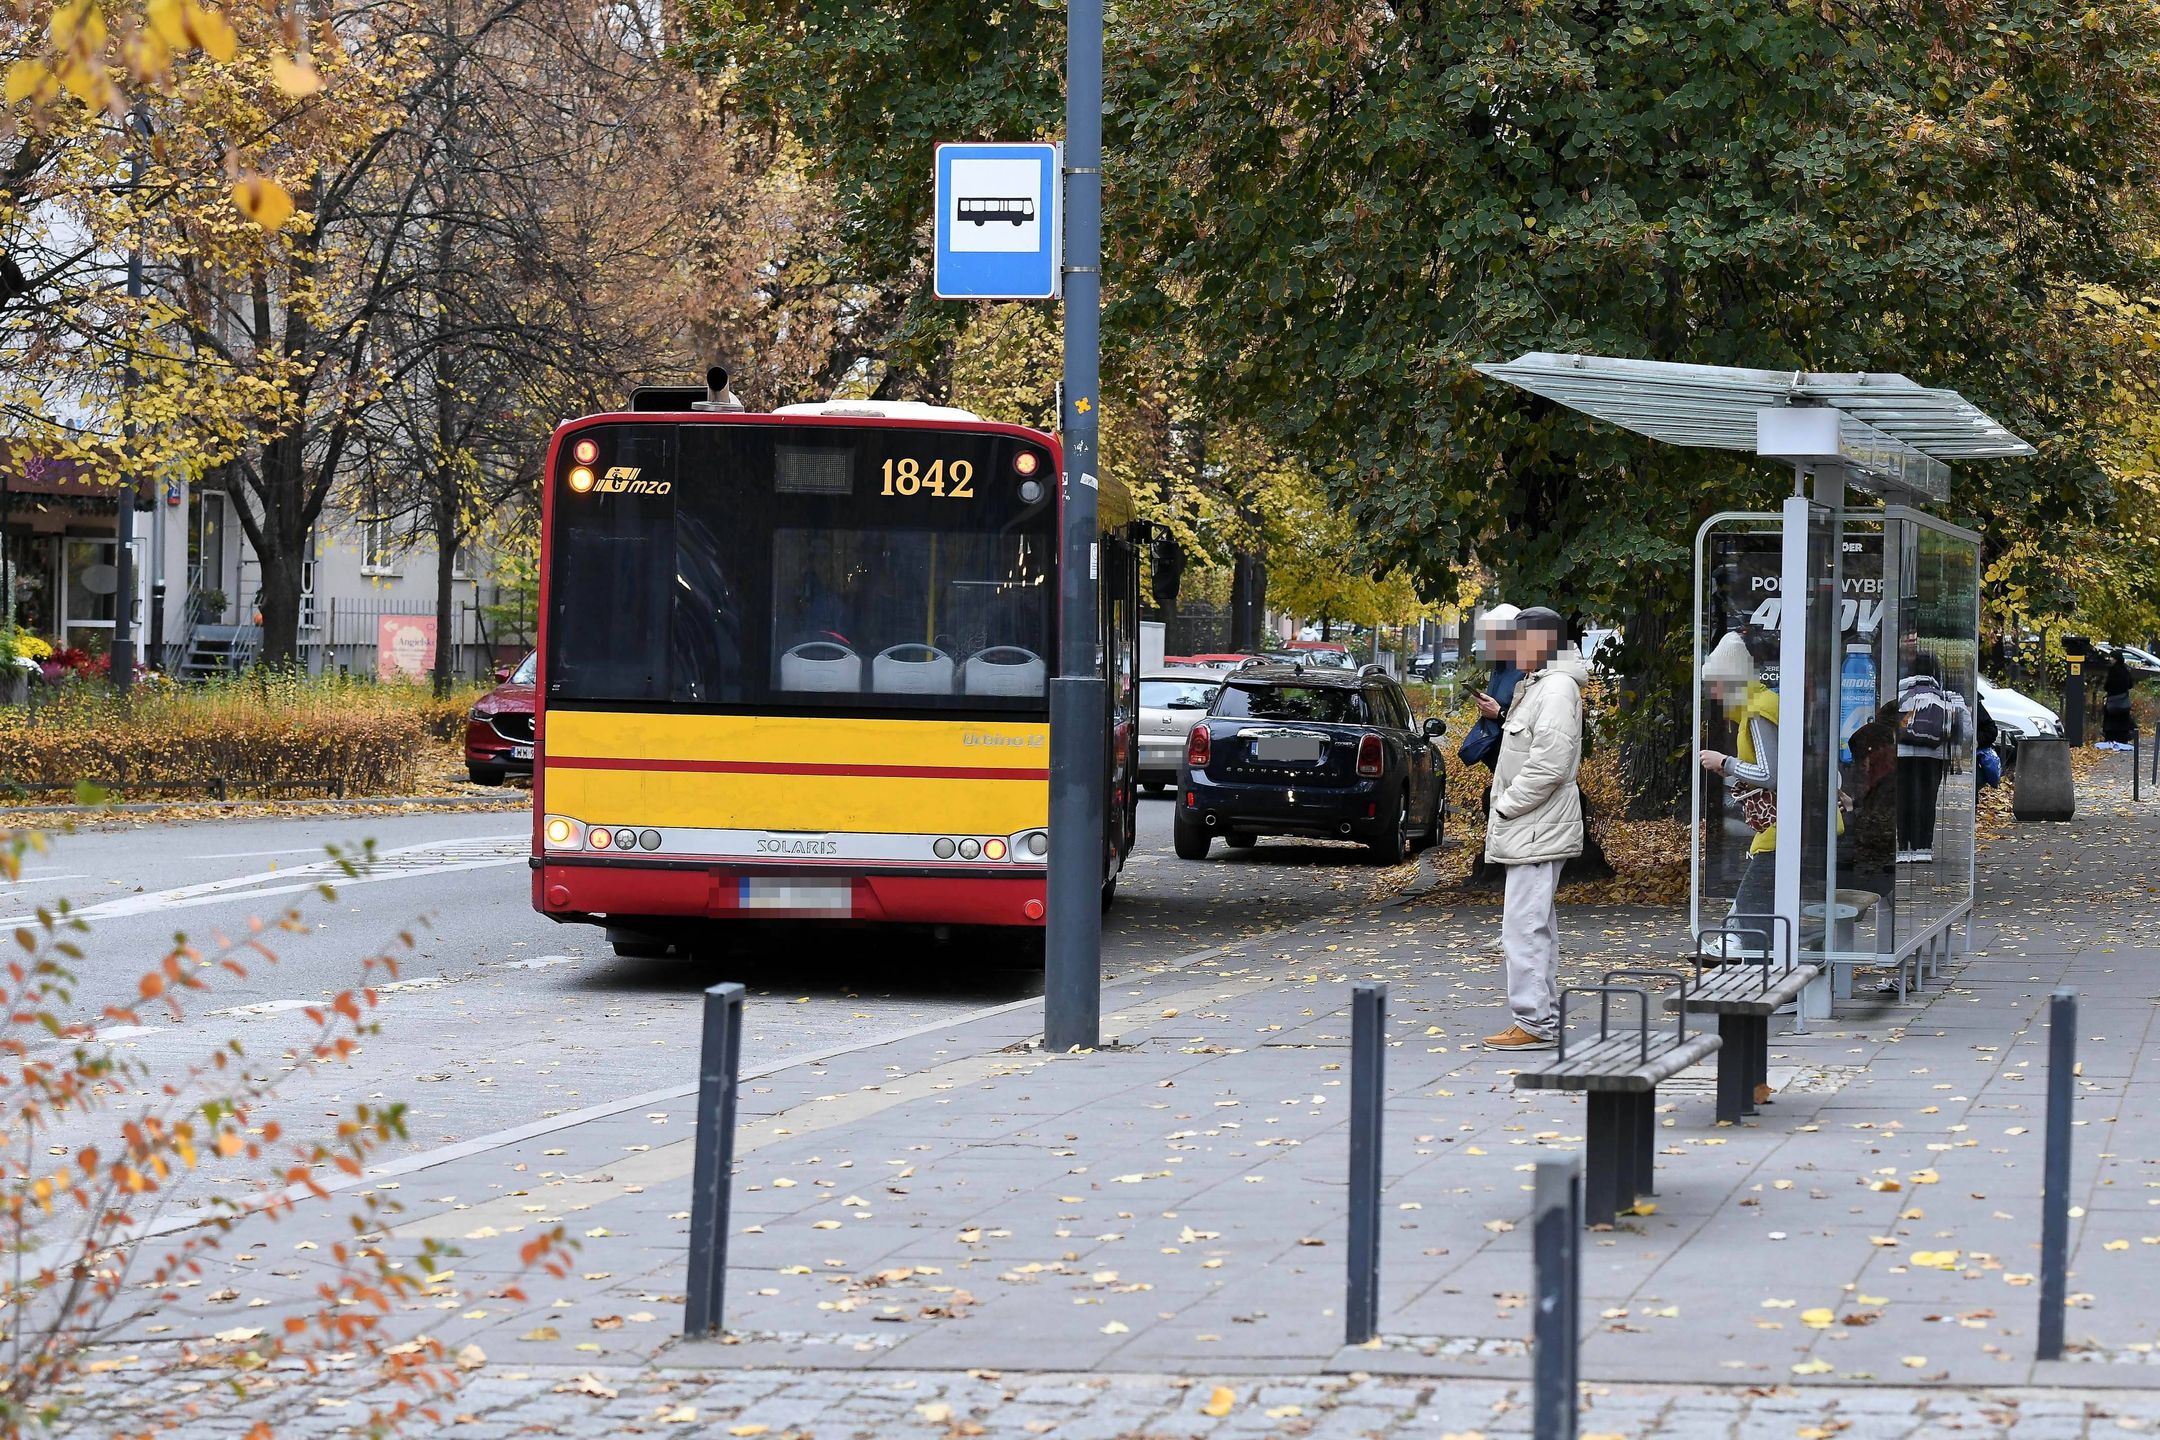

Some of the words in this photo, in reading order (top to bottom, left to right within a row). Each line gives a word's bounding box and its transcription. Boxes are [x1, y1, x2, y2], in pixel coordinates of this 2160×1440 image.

[880, 458, 974, 498] 1842
[627, 480, 672, 495] mza
[963, 733, 1024, 748] Urbino
[1027, 734, 1045, 748] 12
[756, 839, 837, 855] SOLARIS
